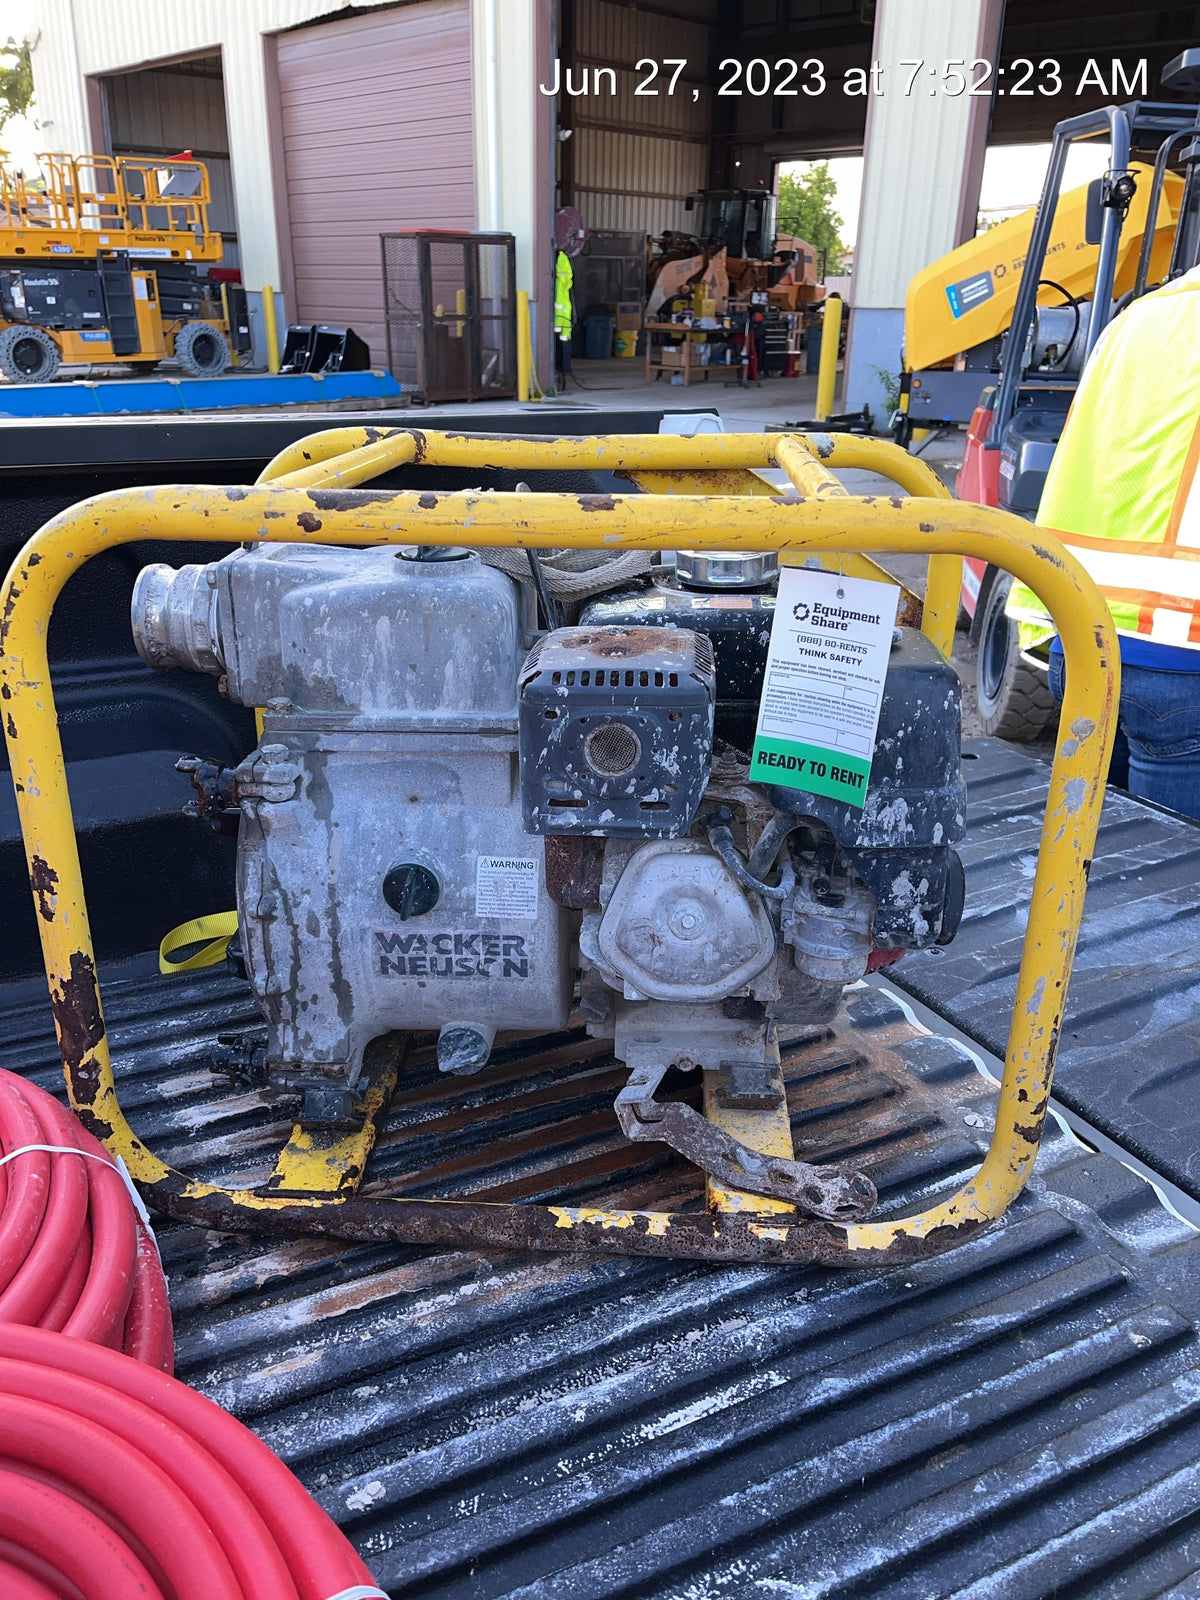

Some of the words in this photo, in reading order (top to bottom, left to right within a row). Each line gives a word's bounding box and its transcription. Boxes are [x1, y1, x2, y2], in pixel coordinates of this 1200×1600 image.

[811, 615, 849, 631] Share
[813, 602, 881, 626] Equipment
[797, 633, 822, 648] (888)
[824, 636, 868, 655] 80-RENTS
[799, 647, 828, 662] THINK
[829, 652, 863, 667] SAFETY
[757, 751, 806, 771] READY
[809, 761, 828, 777] TO
[830, 765, 865, 789] RENT
[490, 860, 534, 870] WARNING
[375, 932, 528, 956] WACKER
